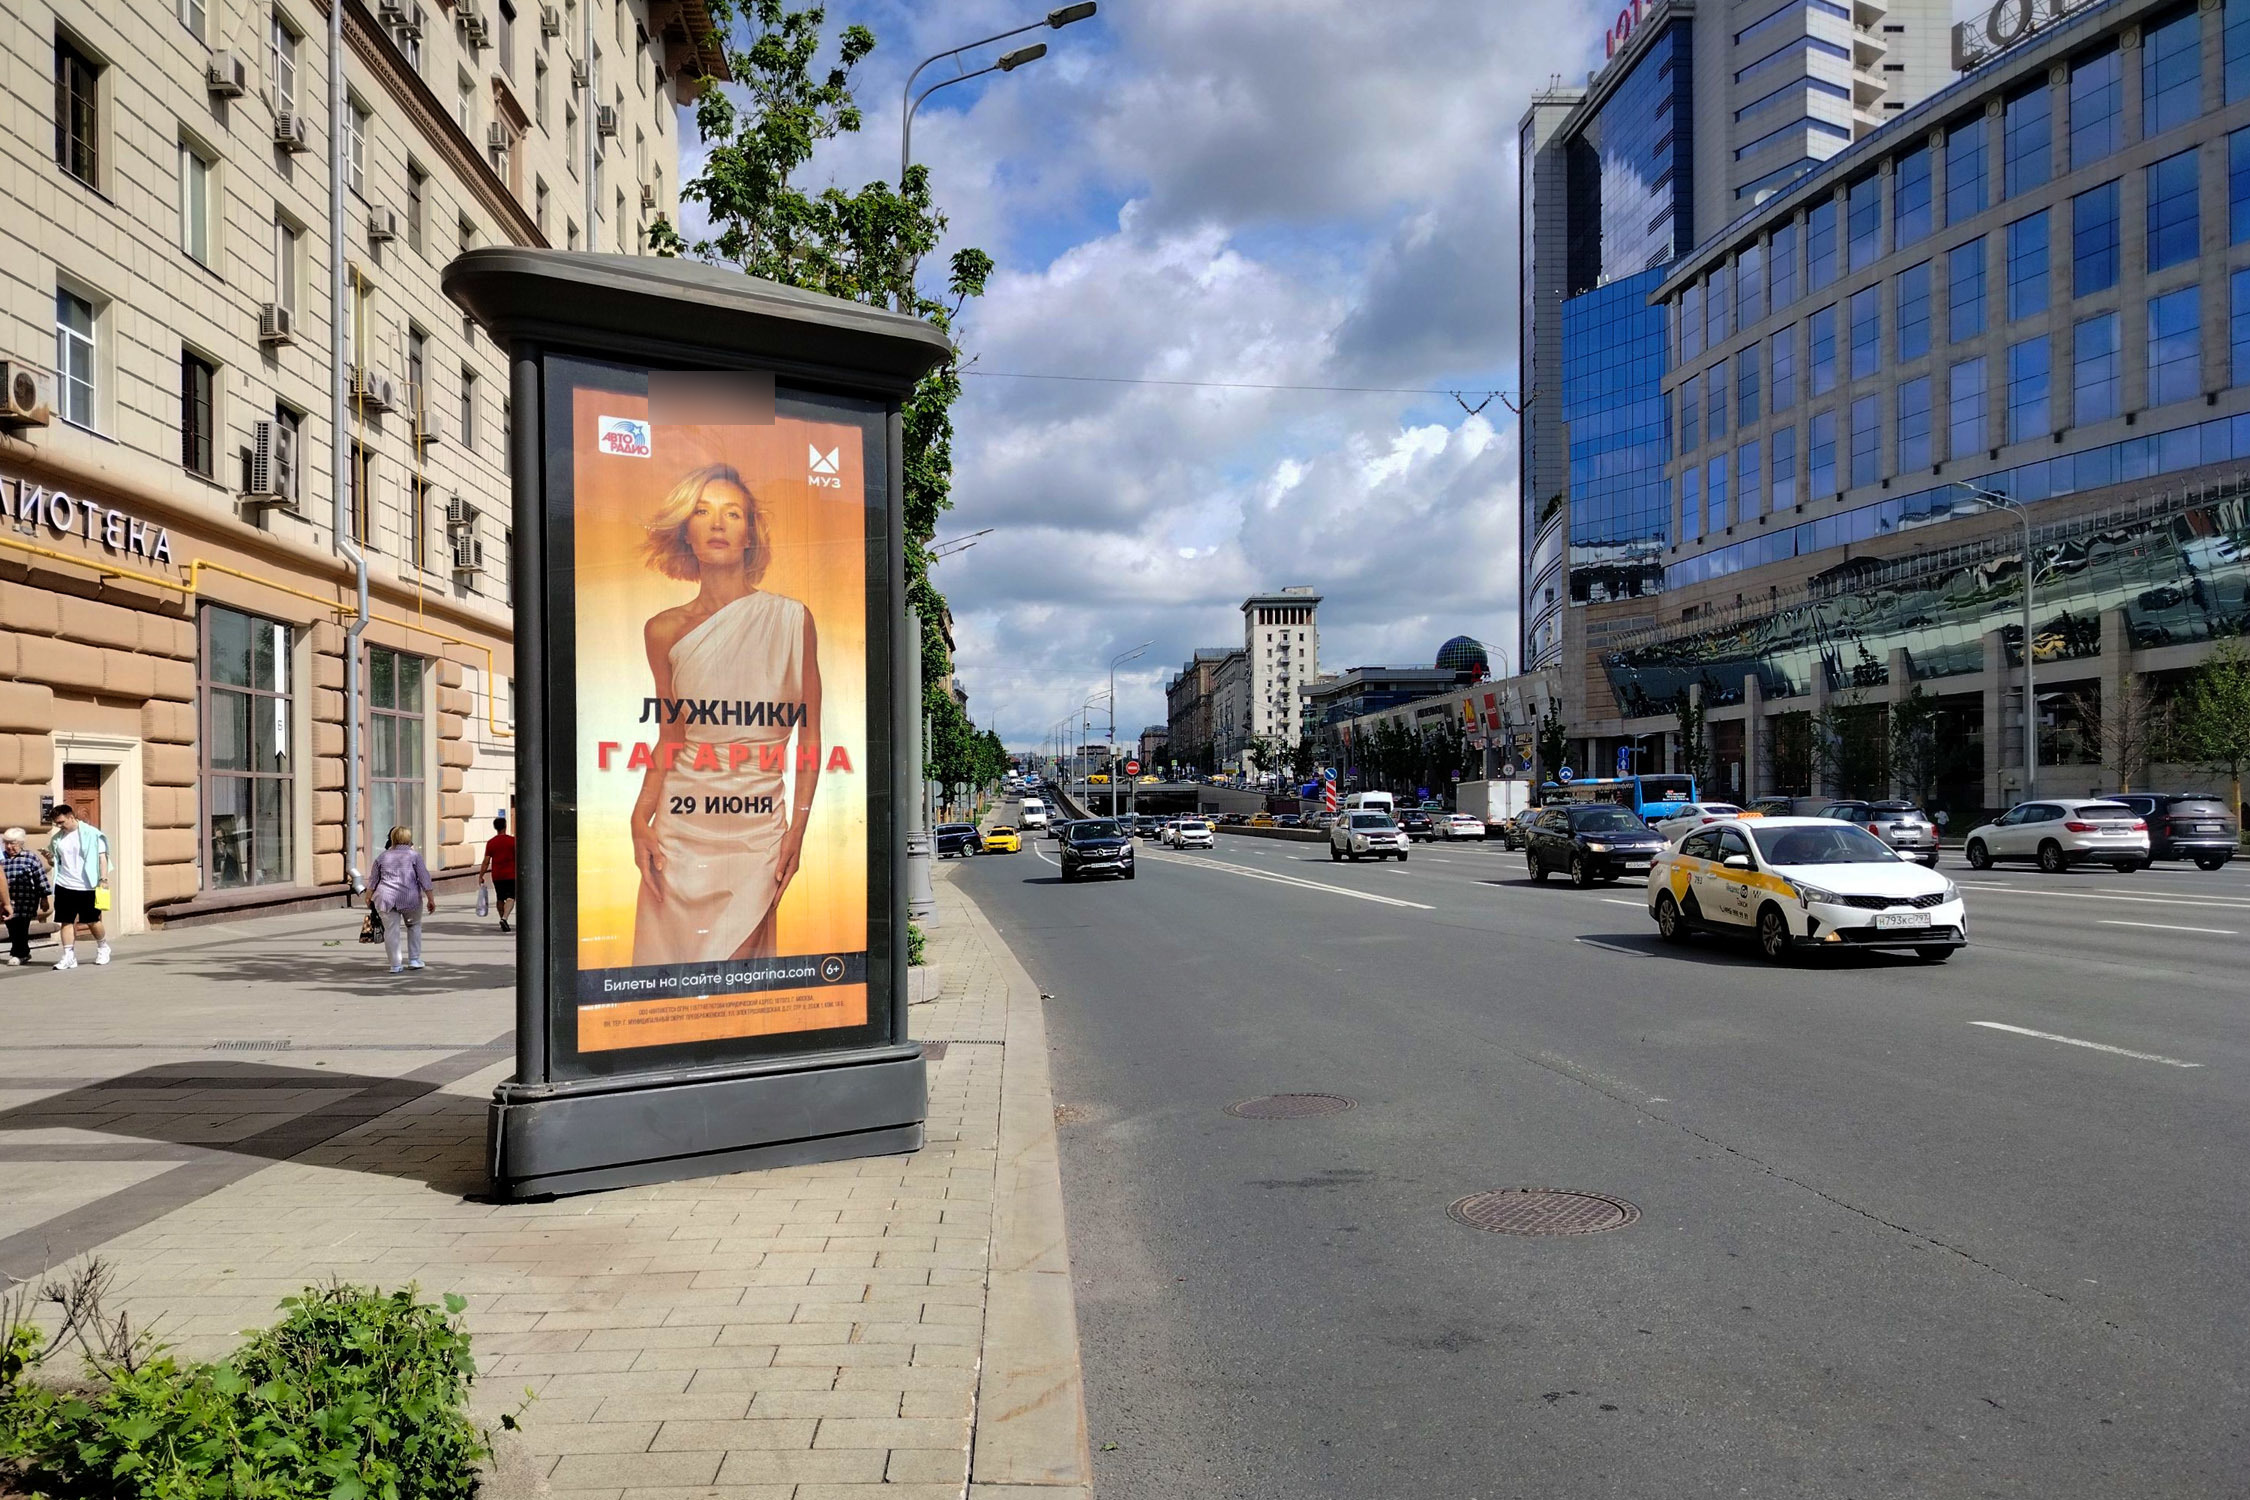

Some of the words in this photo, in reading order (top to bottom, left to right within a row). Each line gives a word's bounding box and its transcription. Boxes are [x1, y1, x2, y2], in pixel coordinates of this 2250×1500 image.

[1606, 0, 1653, 59] LOT
[601, 431, 633, 444] АВТО
[610, 442, 649, 456] РАДИО
[808, 475, 841, 489] МУЗ
[638, 697, 807, 728] ЛУЖНИКИ
[598, 741, 852, 773] ГАГАРИНА
[670, 796, 696, 815] 29
[704, 796, 773, 814] ИЮНЯ
[826, 963, 840, 975] 6+
[604, 979, 656, 992] Билеты
[660, 977, 677, 987] на
[681, 973, 722, 986] сайте
[725, 968, 816, 985] gagarina.com
